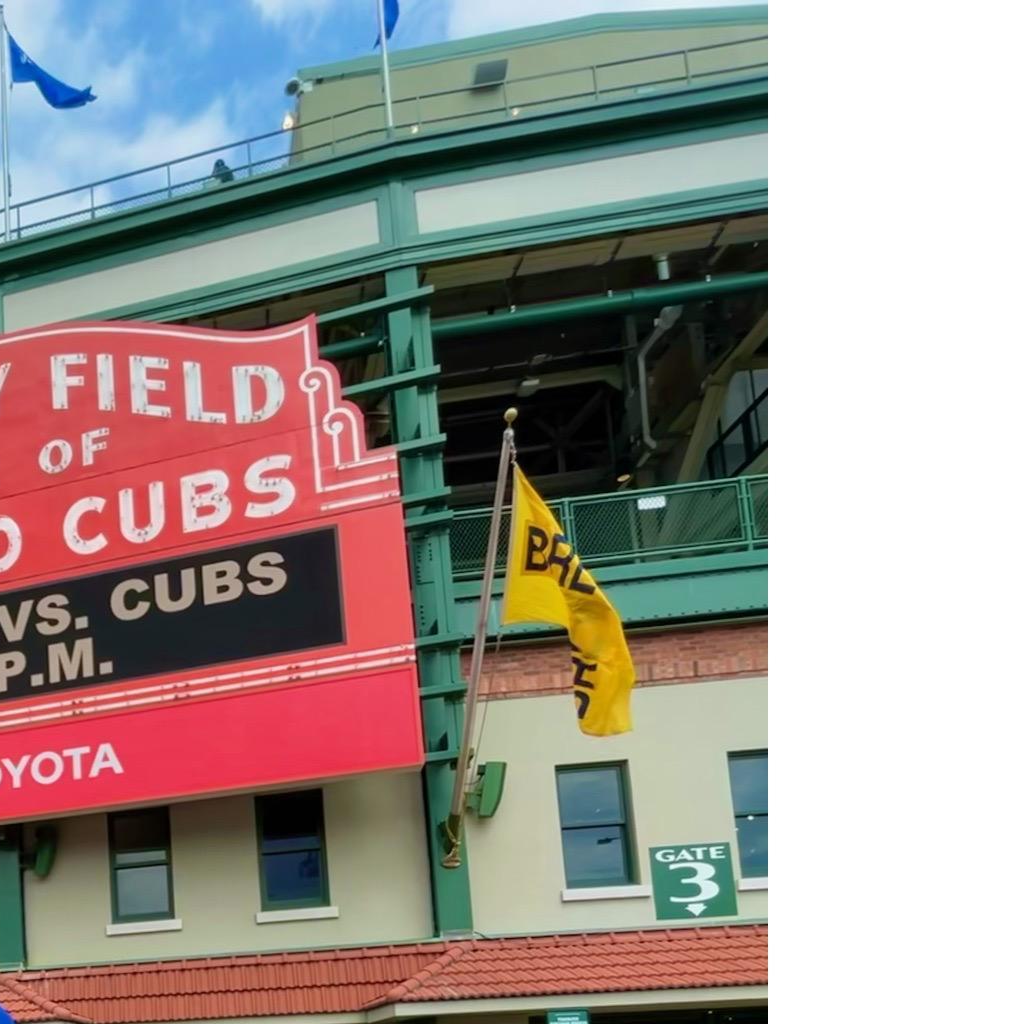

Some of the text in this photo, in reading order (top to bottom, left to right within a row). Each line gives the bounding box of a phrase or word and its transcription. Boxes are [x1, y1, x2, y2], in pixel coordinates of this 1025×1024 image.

[50, 353, 285, 425] FIELD
[38, 427, 110, 474] OF
[62, 454, 297, 555] CUBS
[109, 551, 288, 621] CUBS
[655, 845, 726, 863] GATE
[668, 861, 720, 903] 3
